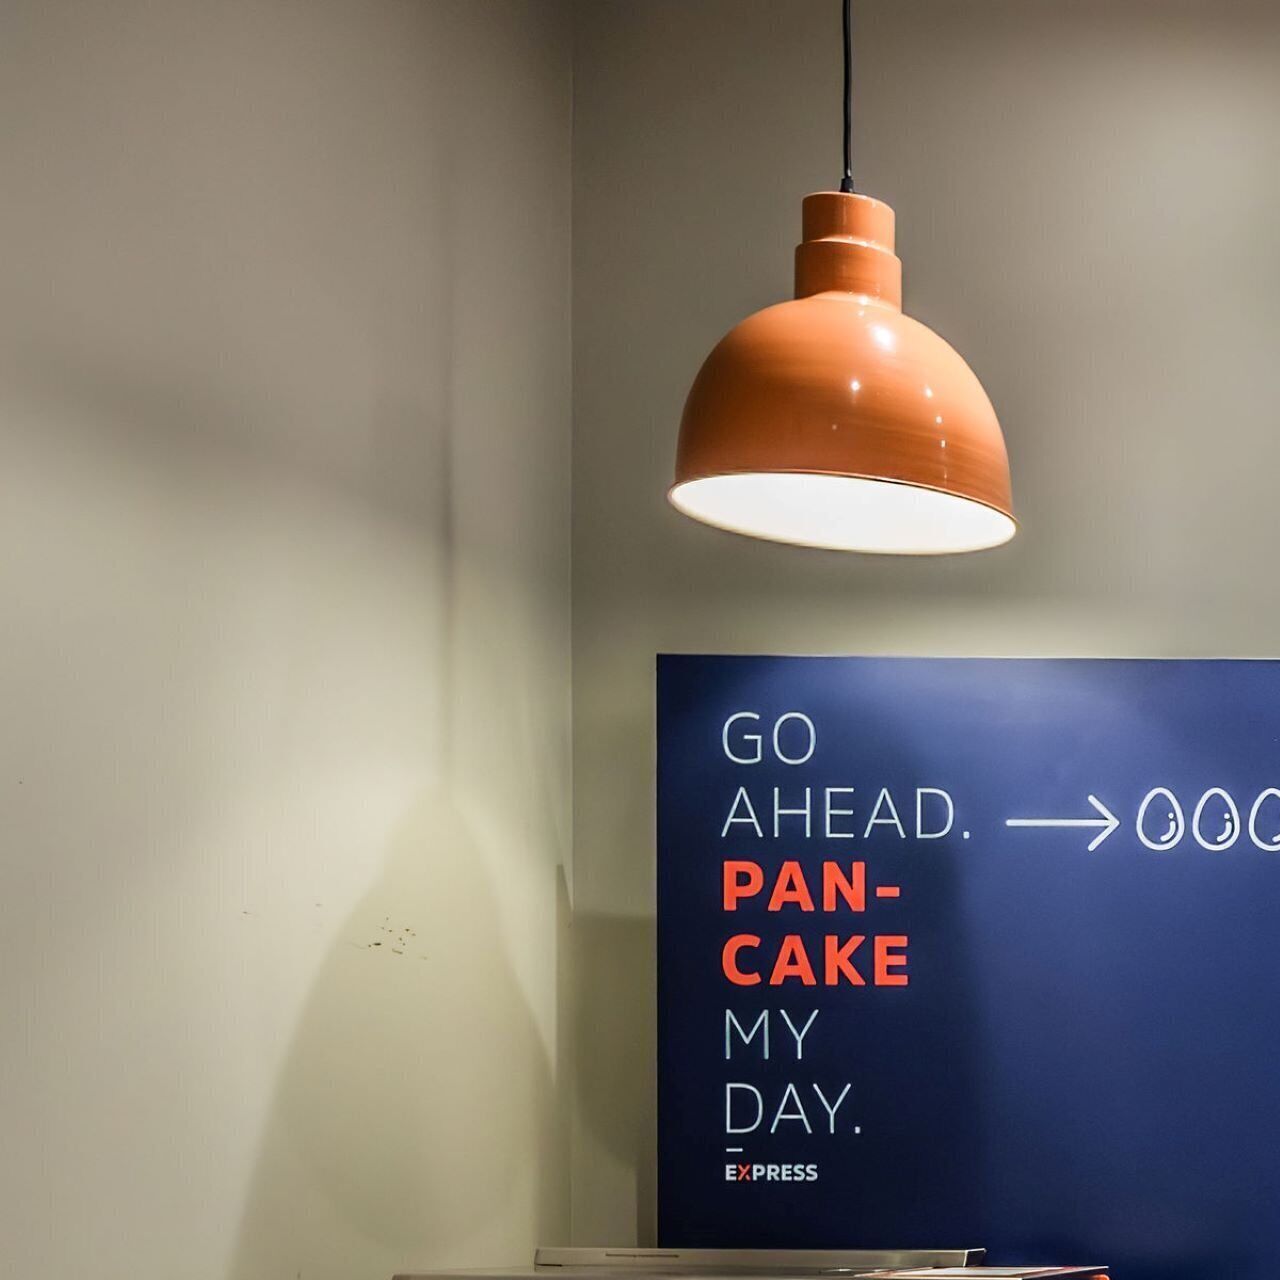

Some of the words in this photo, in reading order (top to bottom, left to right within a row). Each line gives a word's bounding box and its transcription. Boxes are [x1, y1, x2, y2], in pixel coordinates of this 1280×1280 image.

[721, 711, 817, 765] GO
[720, 786, 971, 840] AHEAD.
[722, 860, 901, 912] PAN-
[721, 934, 909, 986] CAKE
[724, 1008, 819, 1060] MY
[724, 1082, 862, 1134] DAY.
[725, 1163, 819, 1182] EXPRESS
